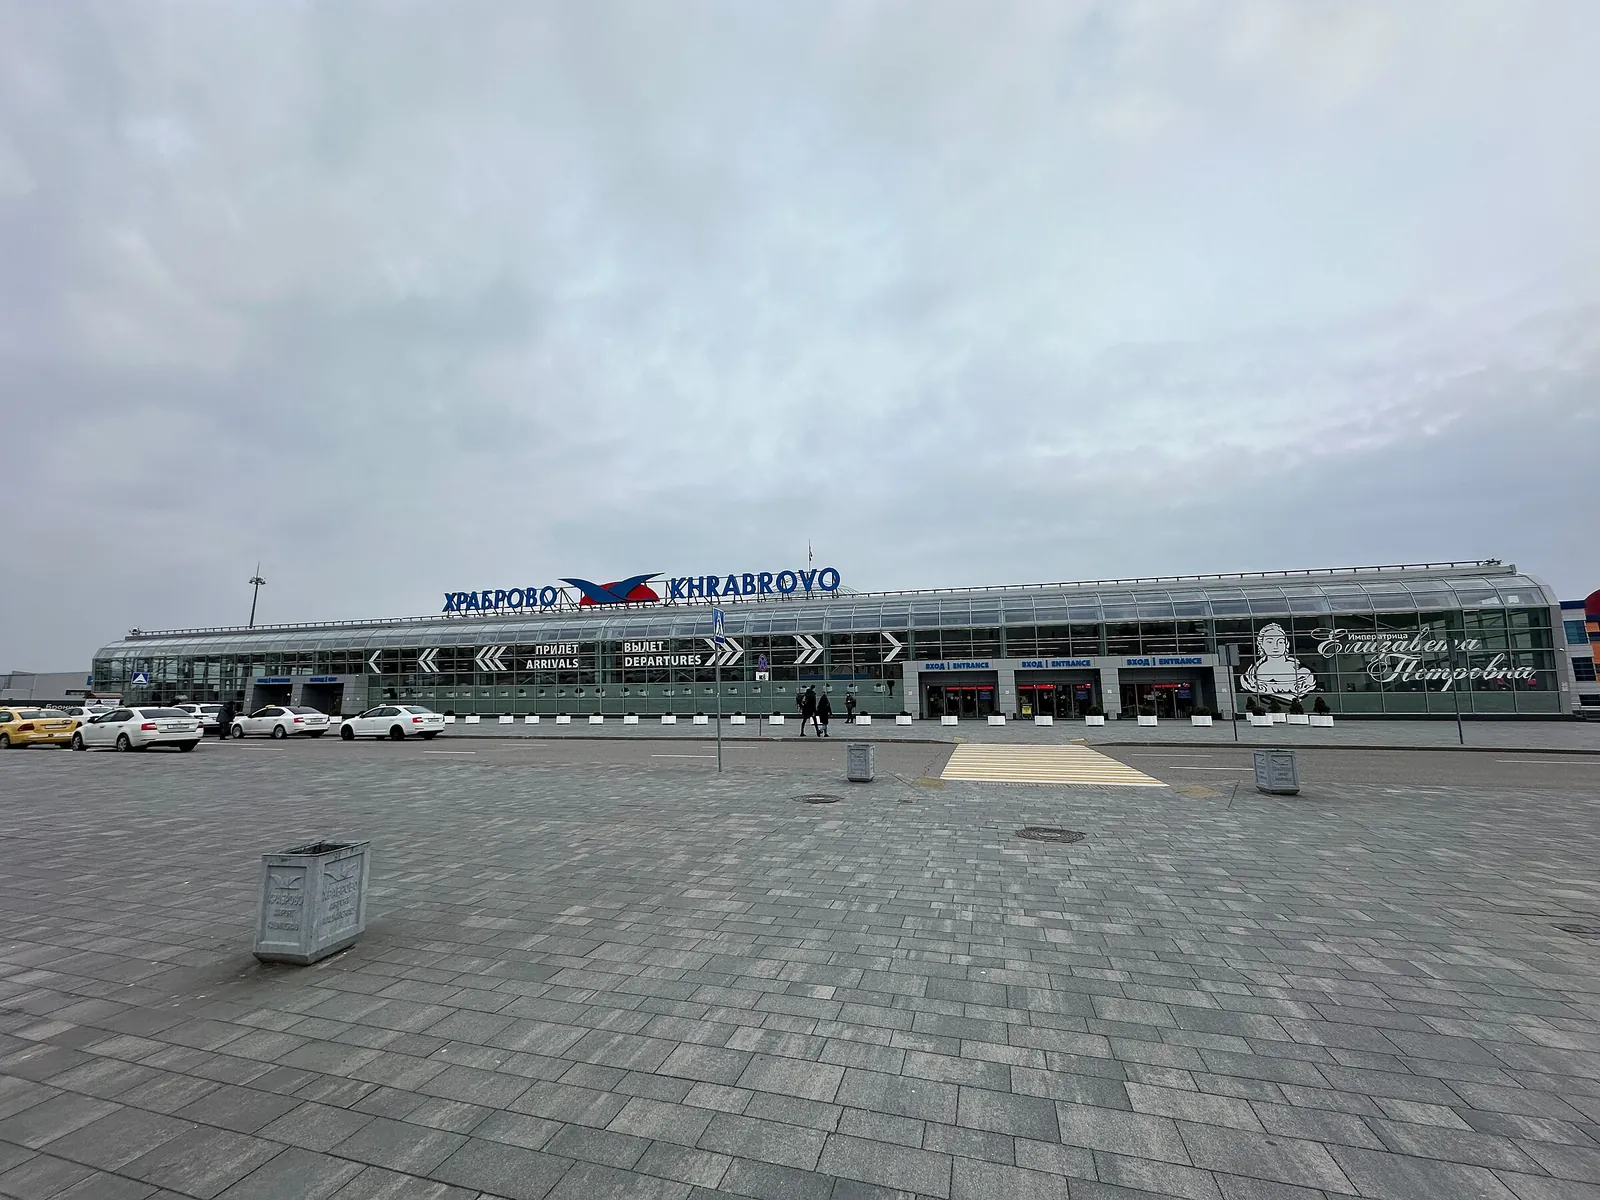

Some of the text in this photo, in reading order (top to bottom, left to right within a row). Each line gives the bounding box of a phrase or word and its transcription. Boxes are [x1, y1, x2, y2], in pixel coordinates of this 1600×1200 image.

[671, 567, 840, 599] KHRABROVO
[442, 585, 558, 612] ХРАБРОВО
[1348, 633, 1408, 641] Императрица
[624, 641, 664, 653] ВЫЛЕТ
[525, 658, 579, 670] ARRIVALS
[624, 655, 702, 667] DEPARTURES
[1127, 658, 1150, 666] ВХОД
[1366, 652, 1537, 691] Петровна
